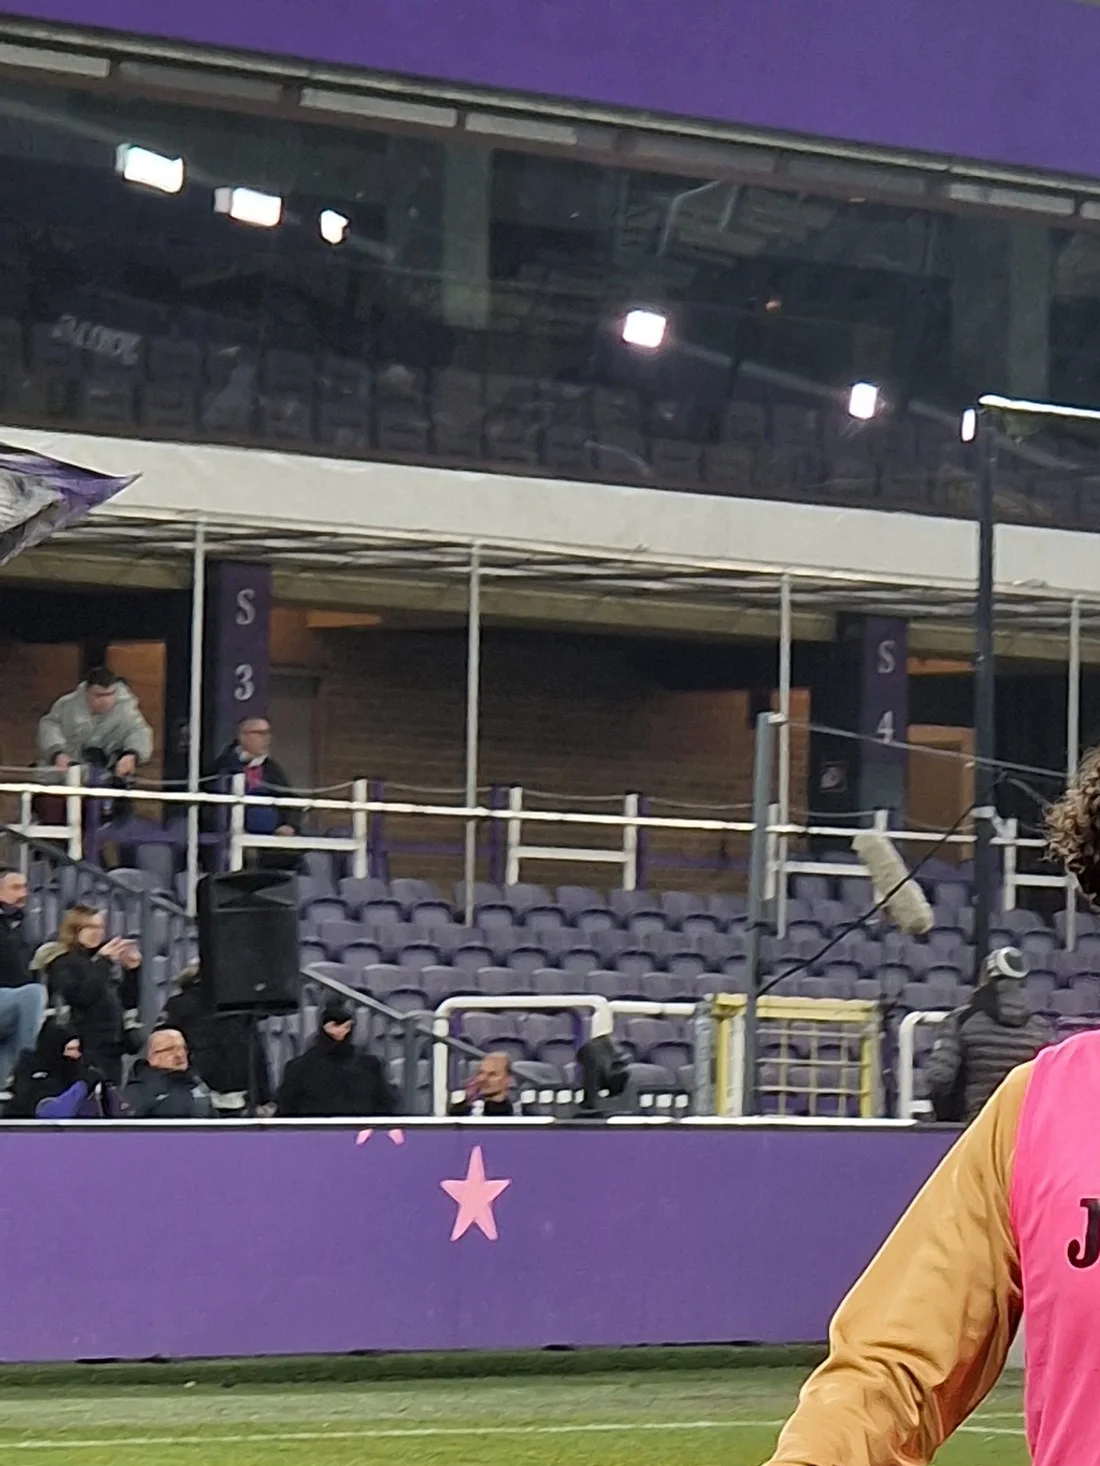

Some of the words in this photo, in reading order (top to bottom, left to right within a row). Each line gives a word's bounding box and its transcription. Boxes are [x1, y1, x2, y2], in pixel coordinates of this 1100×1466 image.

[236, 588, 256, 625] S
[878, 640, 896, 674] S
[234, 664, 255, 701] 3
[877, 710, 895, 745] 4
